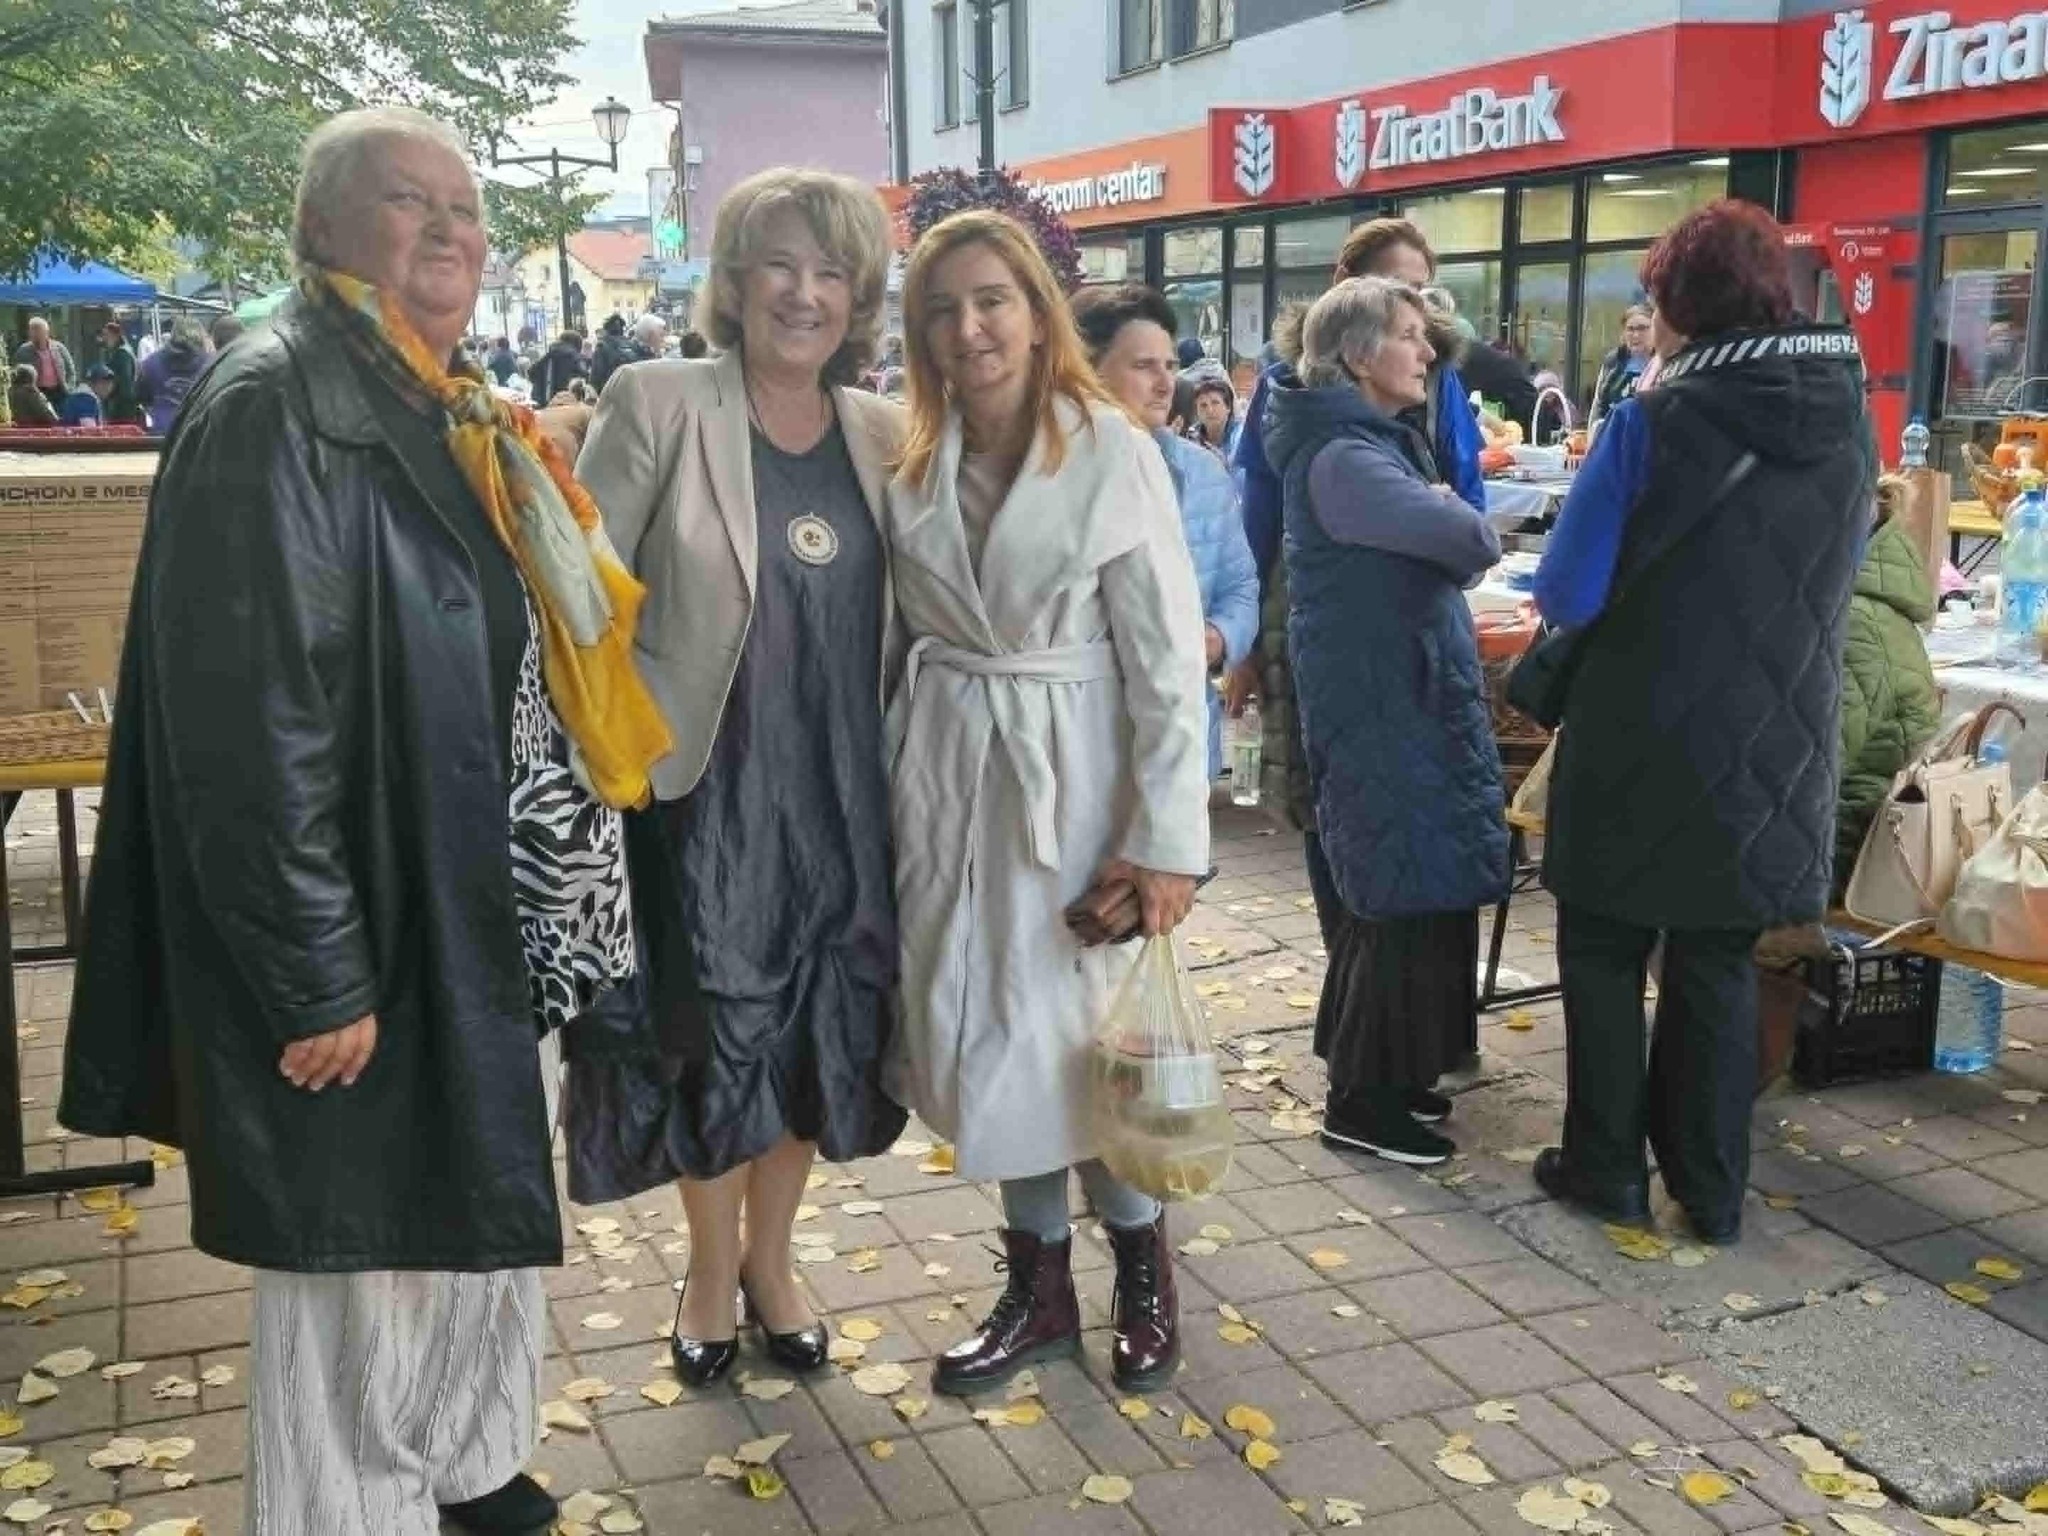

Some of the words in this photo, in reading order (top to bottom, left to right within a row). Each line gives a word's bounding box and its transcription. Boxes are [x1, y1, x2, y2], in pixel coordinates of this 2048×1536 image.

[1883, 11, 2048, 100] Ziraa
[1370, 74, 1566, 169] ZiraatBank
[1096, 160, 1167, 207] centar
